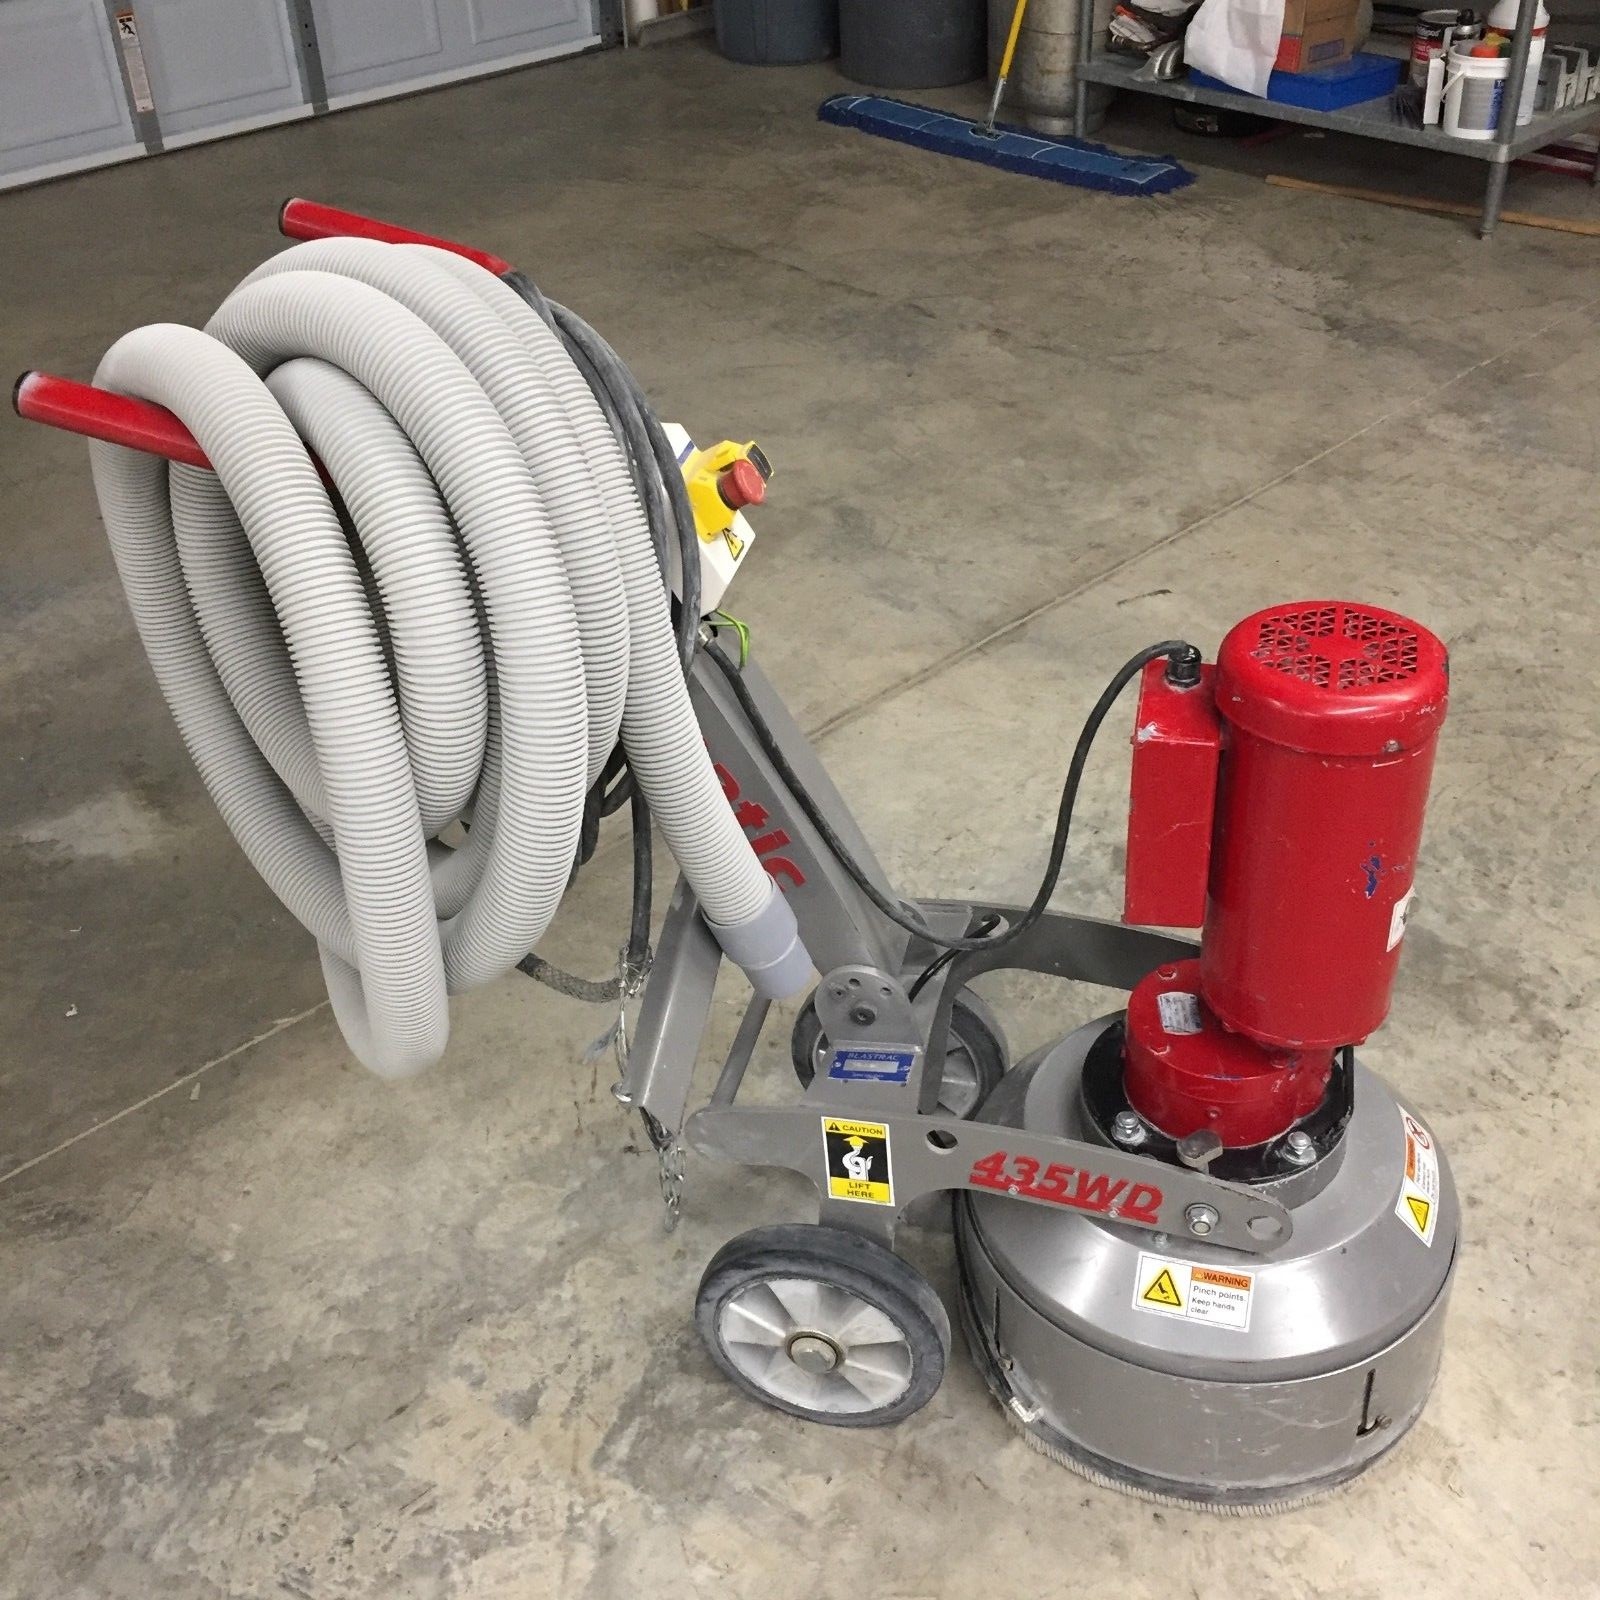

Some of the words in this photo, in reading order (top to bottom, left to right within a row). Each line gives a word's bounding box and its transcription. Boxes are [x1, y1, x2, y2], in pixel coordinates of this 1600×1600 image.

[847, 1052, 899, 1061] BLASTRAC
[842, 1125, 882, 1134] CAUTION
[970, 1151, 1163, 1221] 435WD
[847, 1190, 874, 1198] HERE
[1203, 1272, 1248, 1287] WARNING
[1193, 1285, 1217, 1296] Pinch
[1191, 1297, 1211, 1307] Keep
[1190, 1307, 1209, 1315] clear
